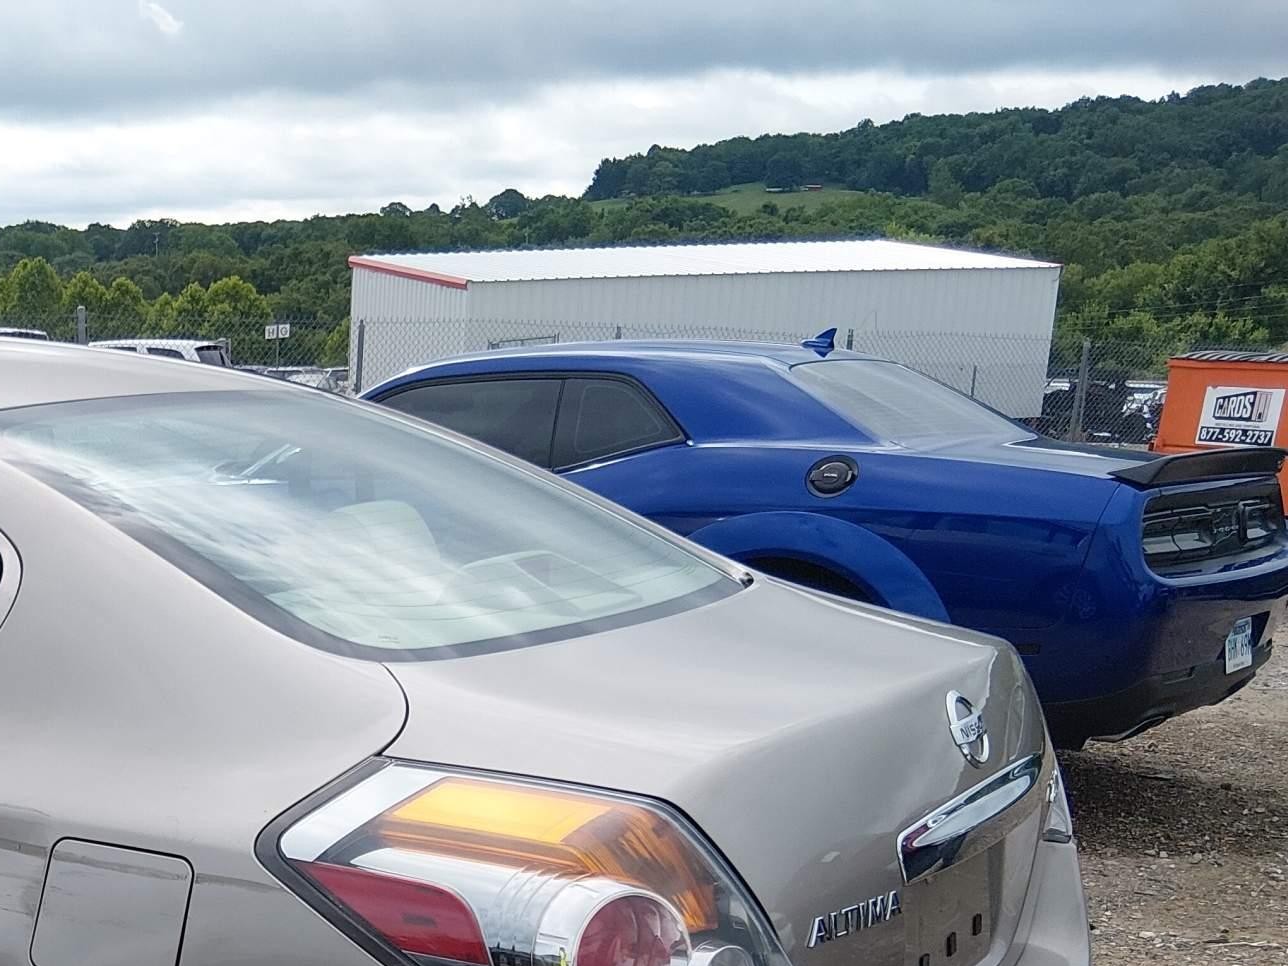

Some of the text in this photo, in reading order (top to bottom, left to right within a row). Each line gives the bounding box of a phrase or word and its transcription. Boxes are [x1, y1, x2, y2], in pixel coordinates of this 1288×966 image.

[1214, 394, 1255, 418] CARDS
[1199, 427, 1273, 444] 877-592-2737
[805, 890, 902, 948] ALTIMA
